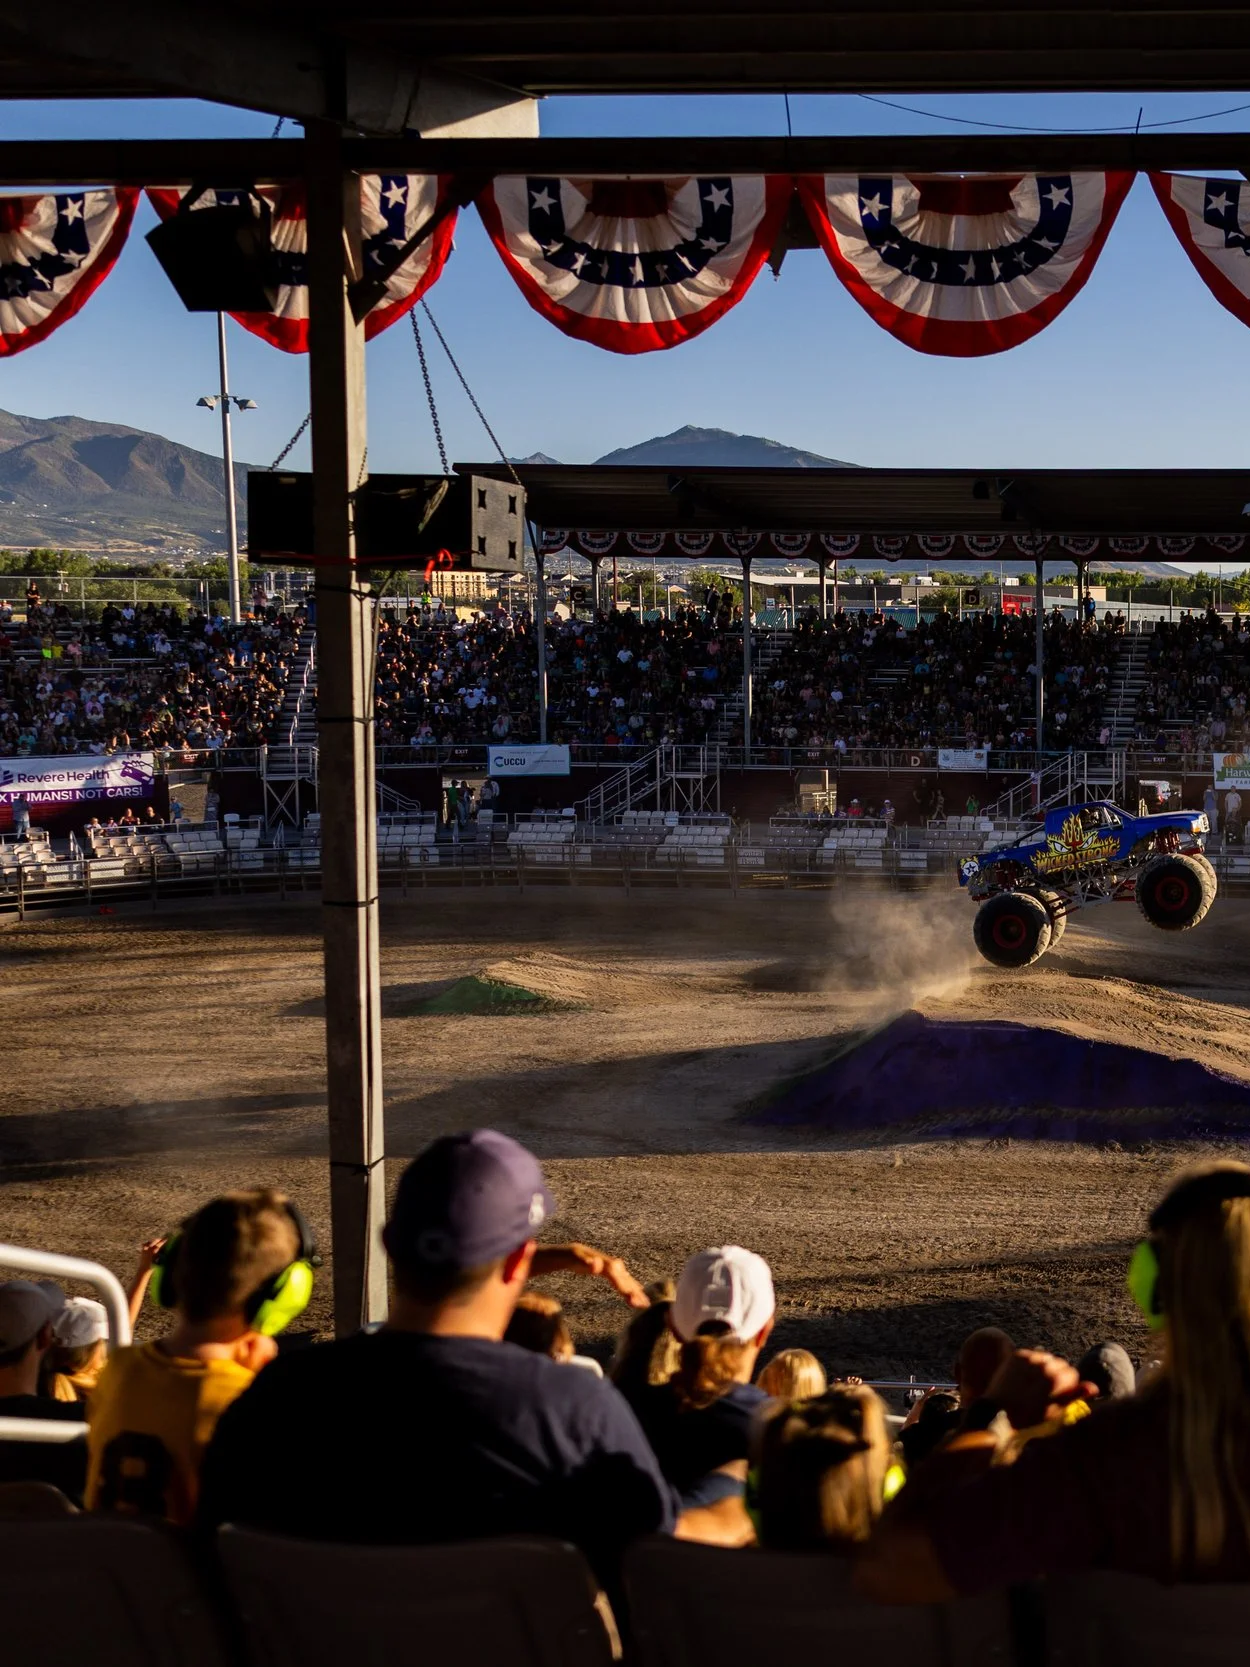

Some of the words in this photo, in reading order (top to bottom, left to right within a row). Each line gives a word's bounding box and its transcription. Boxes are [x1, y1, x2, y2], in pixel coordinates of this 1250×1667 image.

[573, 591, 583, 600] C
[968, 595, 977, 604] D
[910, 755, 921, 767] D
[17, 773, 65, 783] Revere
[66, 769, 110, 781] Health
[75, 789, 104, 800] NOT
[106, 787, 143, 798] CARS!
[1036, 854, 1075, 871] WICKED
[1074, 843, 1118, 864] STRONG
